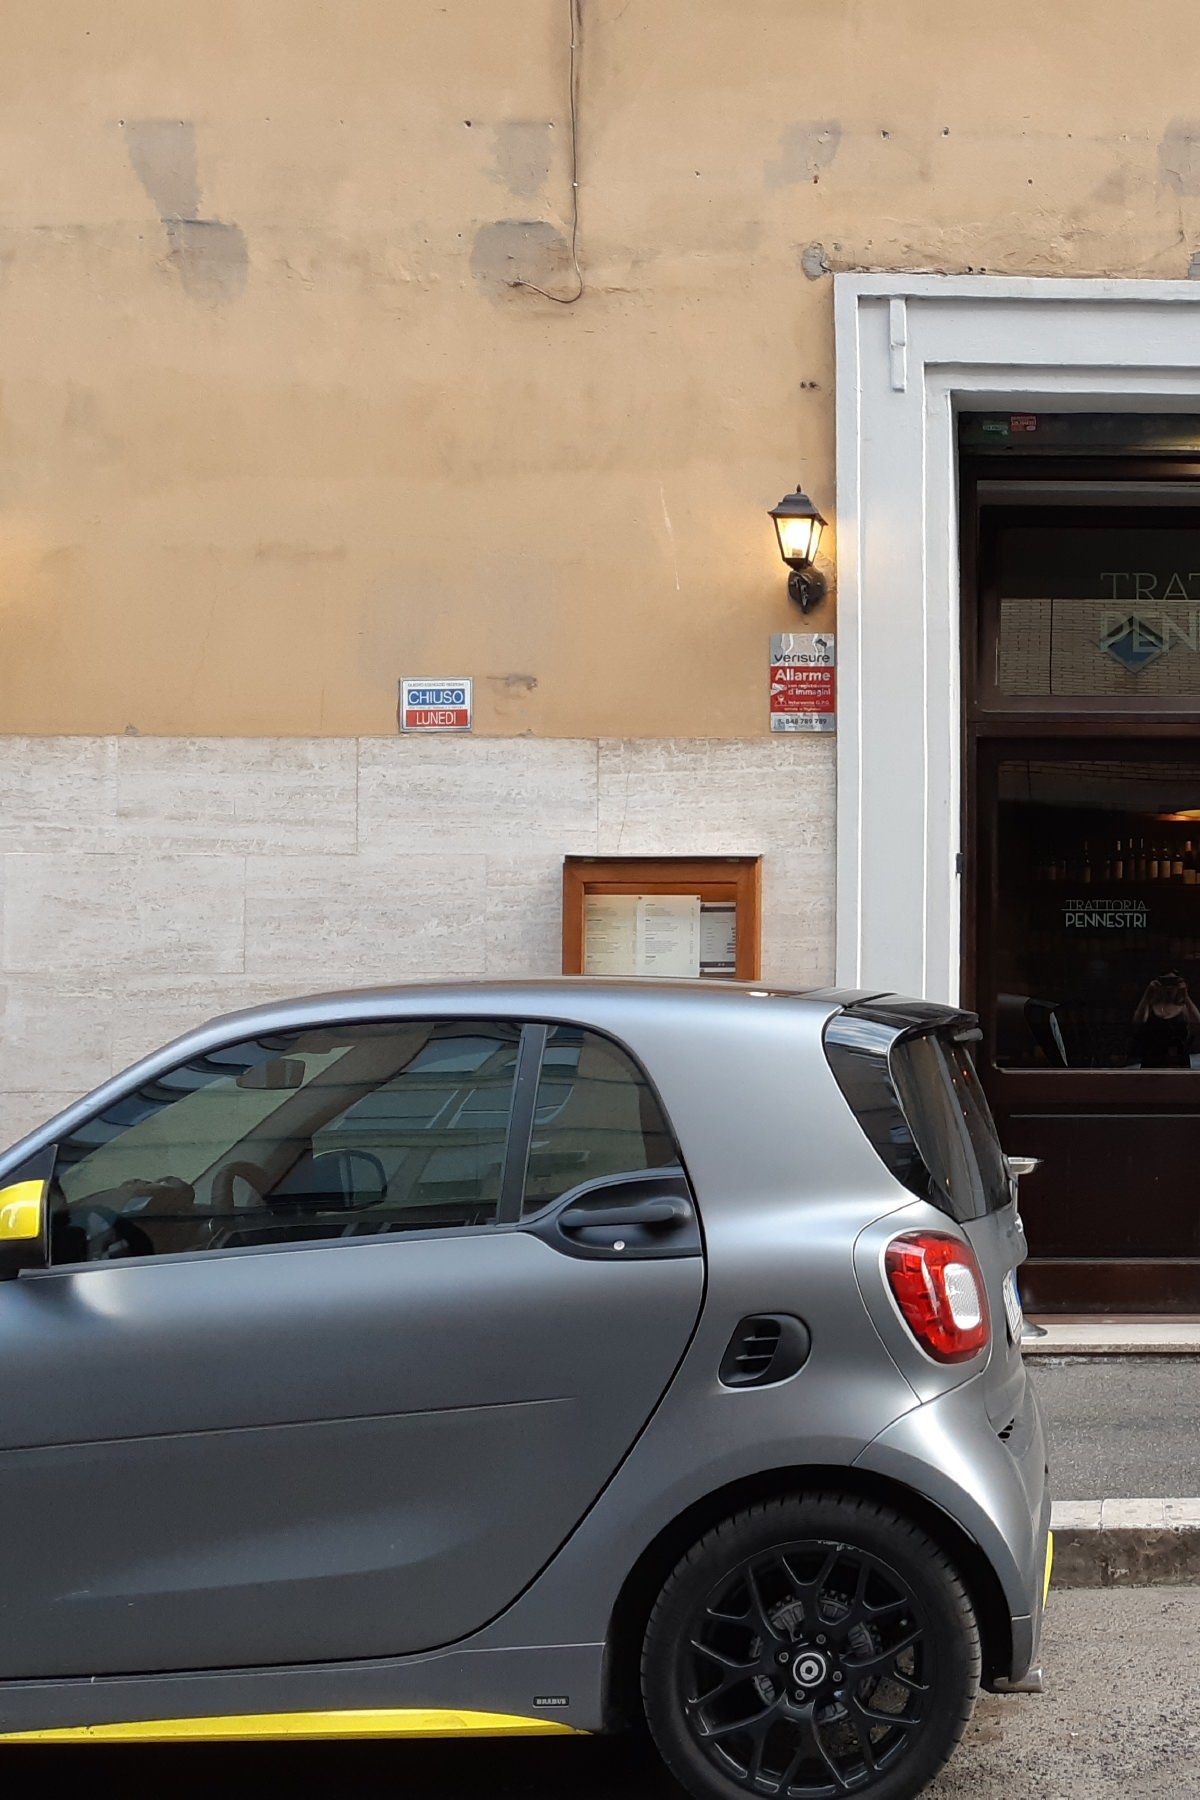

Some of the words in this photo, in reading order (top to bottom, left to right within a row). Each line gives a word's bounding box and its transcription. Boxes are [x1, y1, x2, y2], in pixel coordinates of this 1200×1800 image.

[774, 653, 831, 662] verisure
[775, 668, 831, 681] Allarme
[408, 690, 464, 704] CHIUSO
[416, 711, 456, 725] LUNEDI
[1065, 899, 1146, 910] TRATTORIA
[1065, 913, 1147, 928] PENNESTRI
